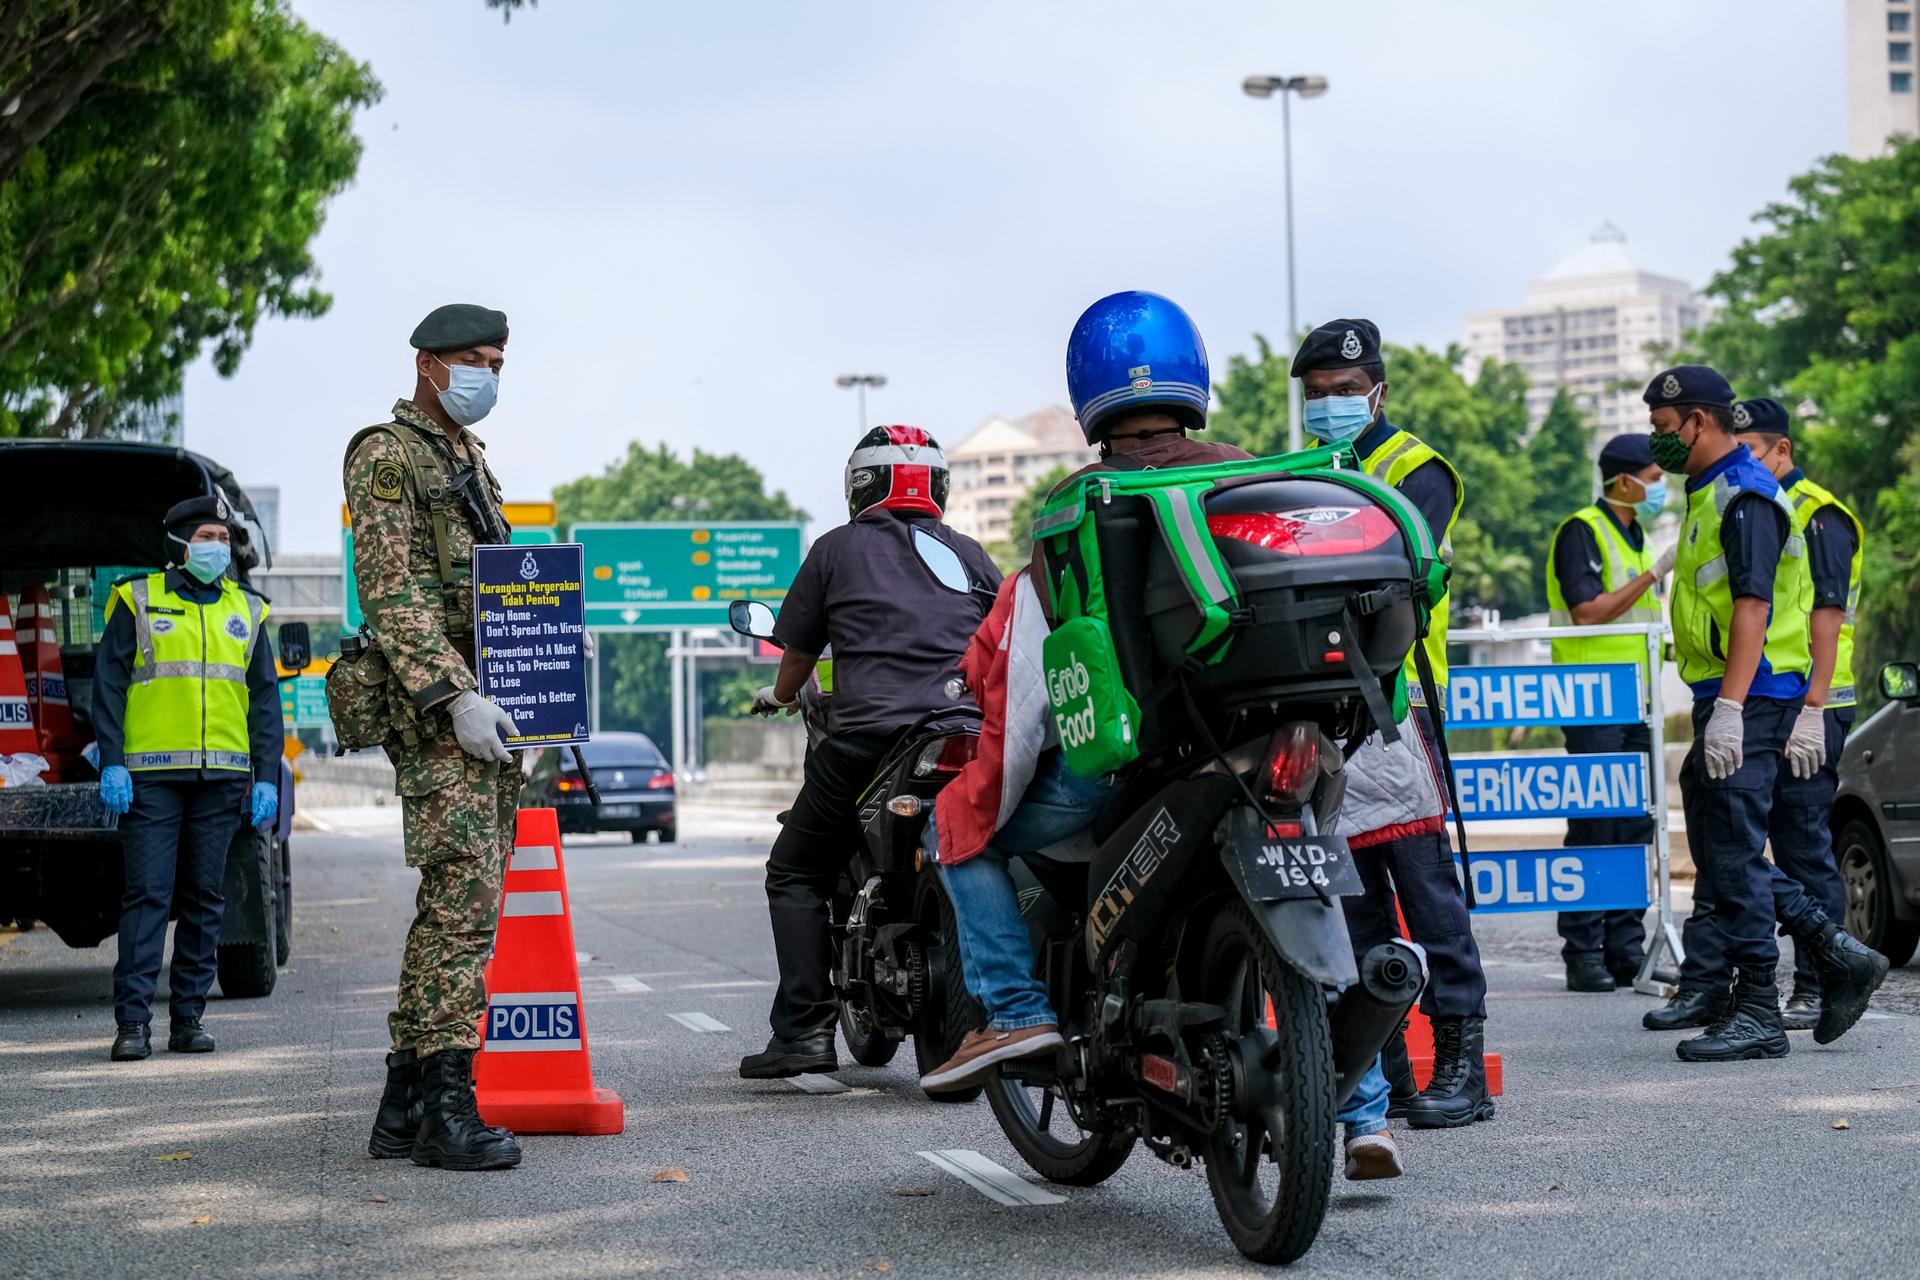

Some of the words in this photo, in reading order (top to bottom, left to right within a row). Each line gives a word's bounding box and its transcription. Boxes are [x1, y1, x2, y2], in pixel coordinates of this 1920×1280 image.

[480, 582, 527, 595] Kurangkan
[529, 580, 580, 595] Pergerakan
[501, 595, 524, 606] Tidak
[526, 594, 560, 607] Penting
[480, 610, 504, 624] #Stay
[507, 610, 531, 621] Home
[486, 625, 509, 637] Don't
[511, 624, 541, 639] Spread
[543, 623, 558, 635] The
[560, 622, 582, 634] Virus
[482, 645, 533, 659] #Prevention
[535, 644, 544, 656] Is
[546, 644, 552, 655] A
[554, 643, 577, 655] Must
[488, 661, 504, 674] Life
[506, 661, 515, 673] Is
[516, 660, 531, 672] Too
[533, 659, 570, 671] Precious
[488, 677, 499, 689] To
[500, 676, 521, 688] Lose
[1047, 651, 1089, 707] Grab
[538, 692, 547, 704] Is
[549, 691, 576, 703] Better
[1445, 673, 1612, 721] RHENTI
[0, 704, 27, 721] LIS
[514, 708, 535, 720] Cure
[1056, 695, 1095, 751] Food
[141, 754, 172, 765] PDRM
[1455, 762, 1638, 813] ERIKSAAN
[1262, 845, 1326, 866] WXD
[1275, 866, 1329, 887] 194
[493, 1006, 573, 1038] POLIS
